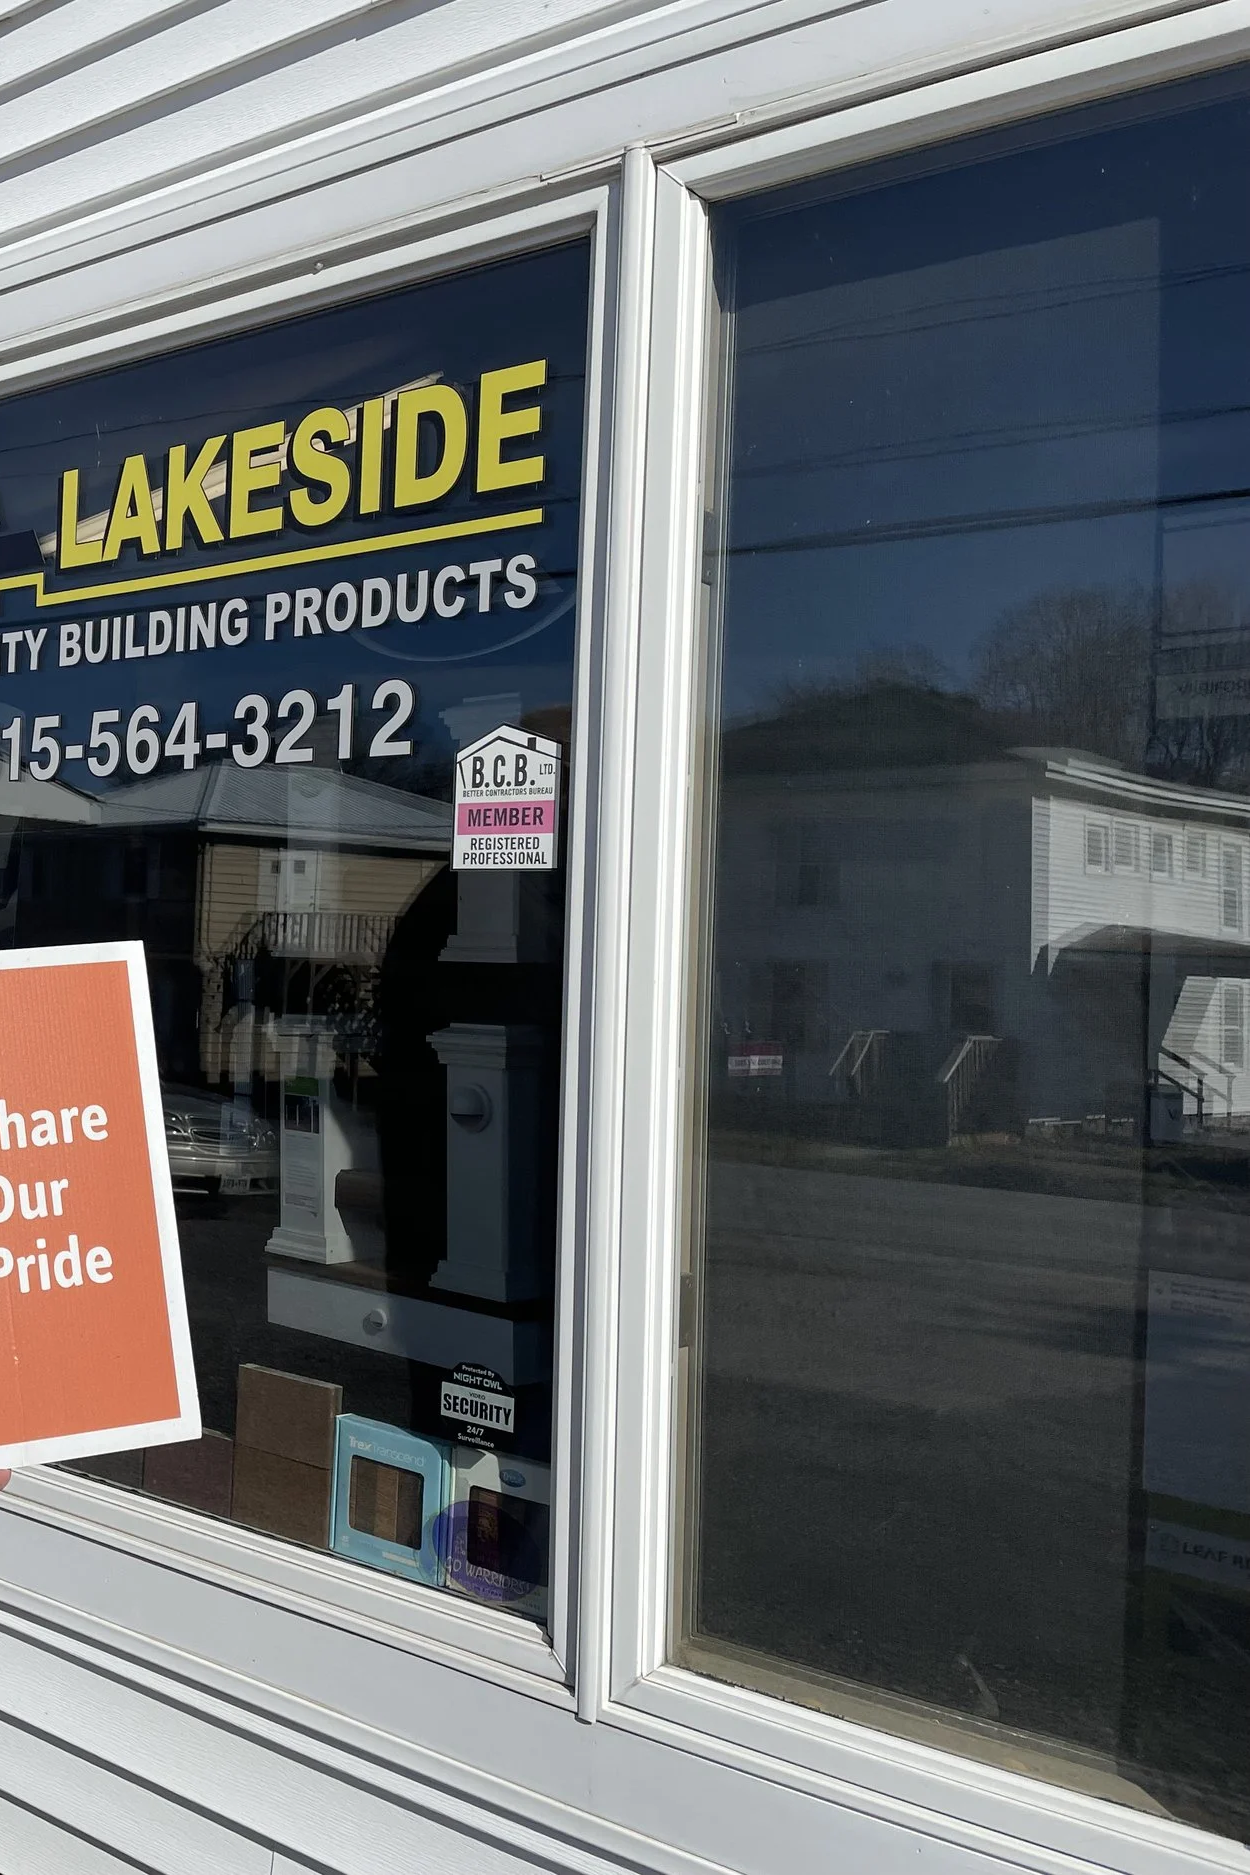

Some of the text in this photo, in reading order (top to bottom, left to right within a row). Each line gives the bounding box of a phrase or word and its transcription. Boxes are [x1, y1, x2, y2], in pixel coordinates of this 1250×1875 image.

[58, 358, 548, 570] LAKESIDE
[58, 597, 250, 668] BUILDING
[264, 553, 539, 641] PRODUCTS
[471, 753, 536, 789] B.C.B.
[462, 786, 553, 798] BETTER CONTRACTORS BUREAU
[467, 806, 544, 828] MEMBER
[470, 836, 540, 851] REGISTERED
[462, 851, 548, 866] PROFESSIONAL
[461, 1364, 495, 1379] Protected By
[453, 1371, 503, 1391] NIGHT OWL
[469, 1391, 486, 1401] VIDEO
[442, 1392, 512, 1426] SECURITY
[466, 1425, 485, 1437] 24/7
[349, 1435, 373, 1452] Trex
[457, 1432, 495, 1449] Surveillance
[1182, 1541, 1229, 1563] LEAF
